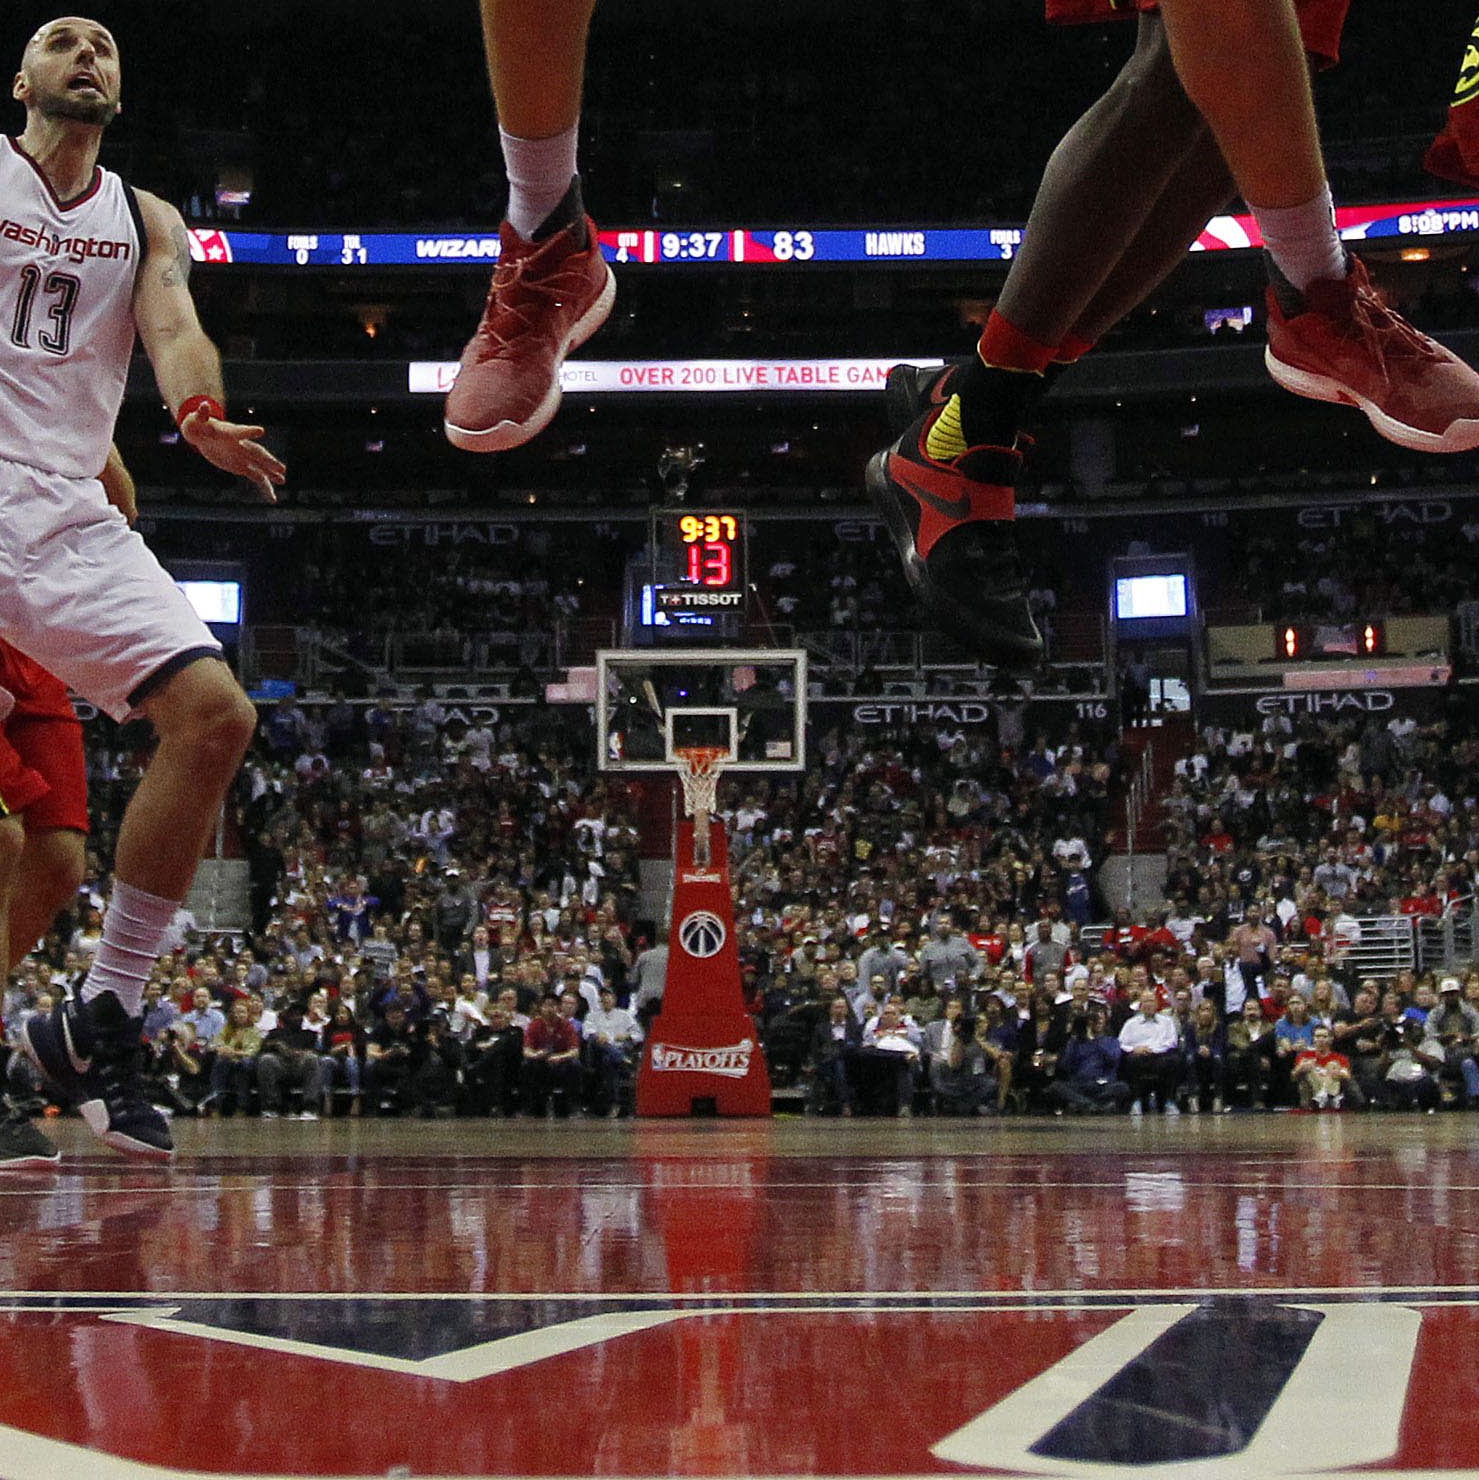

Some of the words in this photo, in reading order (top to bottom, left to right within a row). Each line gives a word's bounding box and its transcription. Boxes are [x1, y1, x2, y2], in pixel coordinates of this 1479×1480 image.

[287, 235, 318, 250] FOULS
[662, 233, 723, 258] 9:37
[773, 230, 815, 261] 83
[865, 232, 925, 256] HAWKS
[990, 229, 1021, 245] FOULS
[1001, 244, 1013, 260] 3
[11, 264, 82, 356] 13
[620, 367, 674, 385] OVER
[681, 367, 717, 385] 200
[723, 366, 769, 385] LIVE
[776, 365, 840, 384] TABLE
[680, 514, 737, 543] 9:37
[687, 542, 732, 587] 13
[680, 593, 742, 605] TISSOT
[1076, 703, 1108, 719] 116
[1255, 690, 1395, 715] ETIHAD
[853, 704, 989, 725] ETIHAD
[662, 1050, 750, 1069] PLAYOFFS
